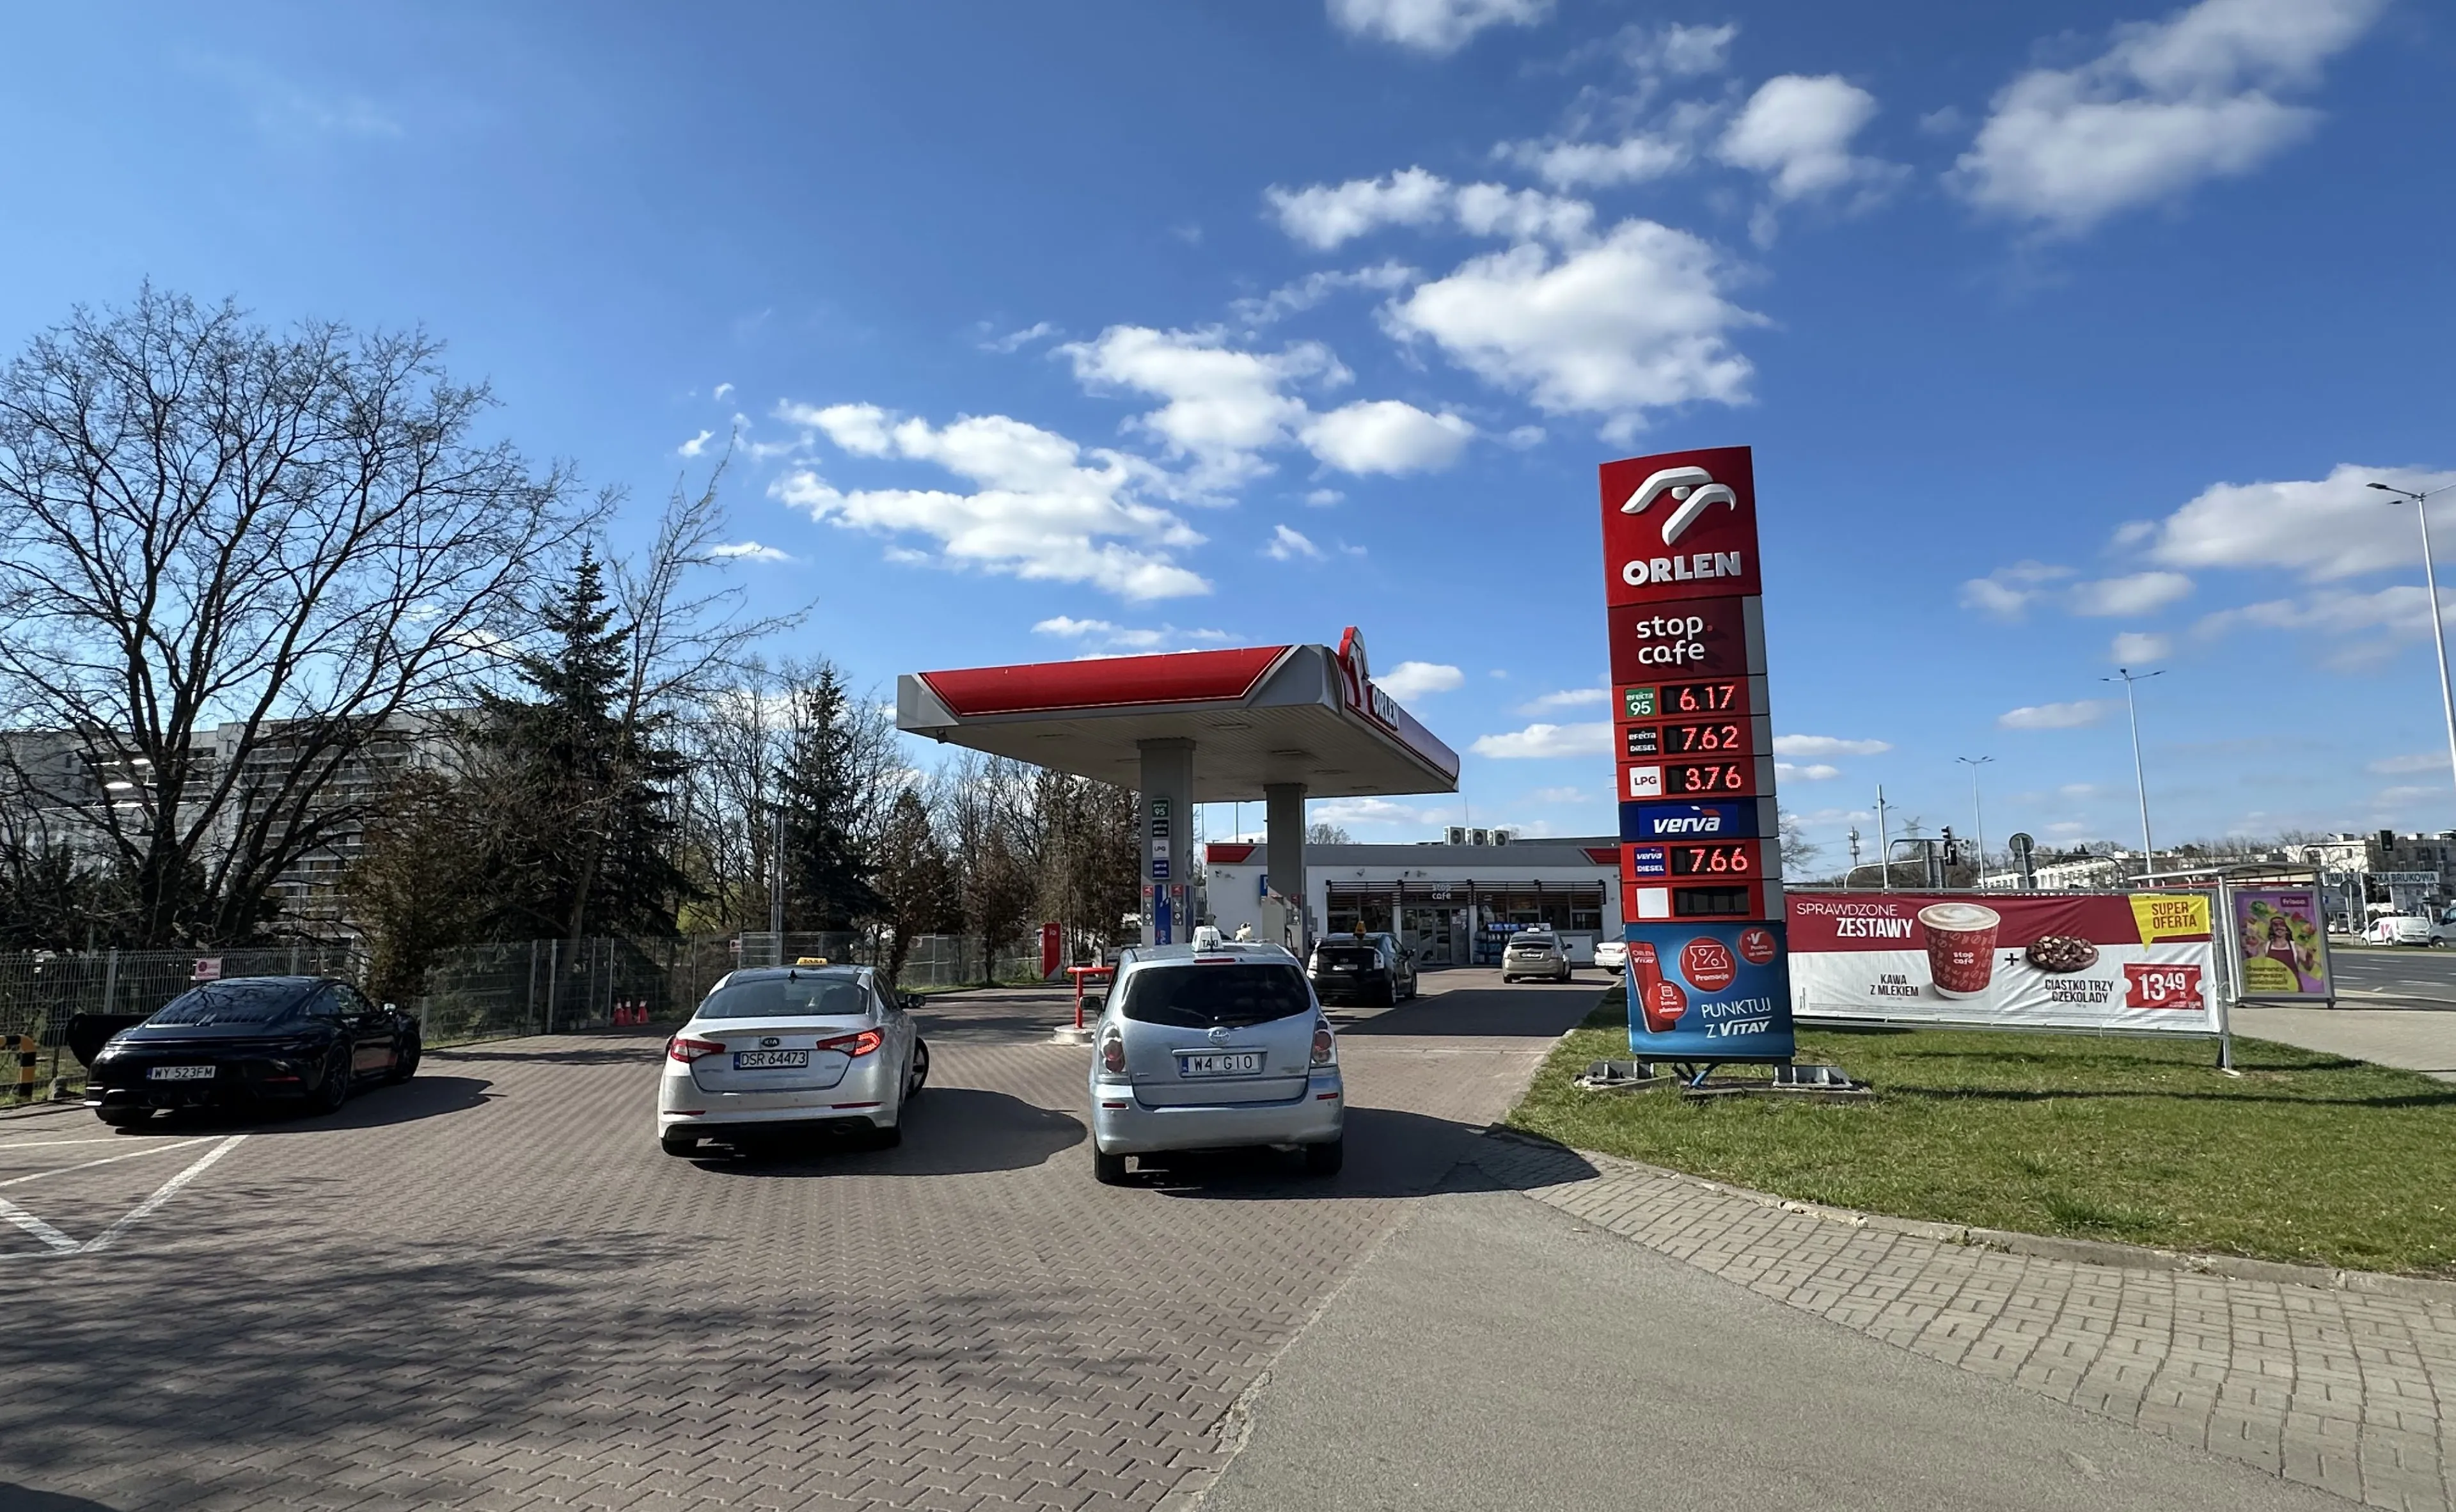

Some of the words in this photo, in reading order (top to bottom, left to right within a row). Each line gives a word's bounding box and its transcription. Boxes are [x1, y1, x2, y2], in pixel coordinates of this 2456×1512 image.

[1623, 551, 1742, 585] ORLEN
[1639, 640, 1705, 665] cafe
[1680, 685, 1735, 711] 6.17
[1630, 701, 1651, 715] 95
[1681, 725, 1739, 750] 7.62
[1630, 744, 1657, 752] DIESEL
[1634, 776, 1657, 786] LPG
[1685, 766, 1742, 791] 3.76
[1653, 817, 1721, 833] verva
[1690, 847, 1748, 872] 7.66
[2391, 873, 2436, 882] BRUKOWA
[1432, 892, 1451, 901] cafe
[1797, 903, 1898, 917] SPRAWDZONE
[2152, 901, 2189, 915] SUPER
[1836, 917, 1914, 938] ZESTAWY
[2153, 914, 2197, 929] OFERTA
[1880, 973, 1907, 985] KAWA
[2045, 979, 2086, 991] CIASTKO
[2088, 980, 2114, 991] TRZY
[1870, 985, 1876, 995] Z
[1878, 986, 1919, 996] MLEKIEM
[2052, 991, 2109, 1003] CZEKOLADY
[1701, 997, 1771, 1018] PUNKTUJ
[1705, 1025, 1717, 1039] Z
[1719, 1016, 1772, 1037] VITAY
[742, 1053, 765, 1066] DSR
[768, 1052, 806, 1064] 64473
[1194, 1057, 1212, 1071] W4
[155, 1068, 170, 1078] WY
[175, 1067, 213, 1078] 523FM
